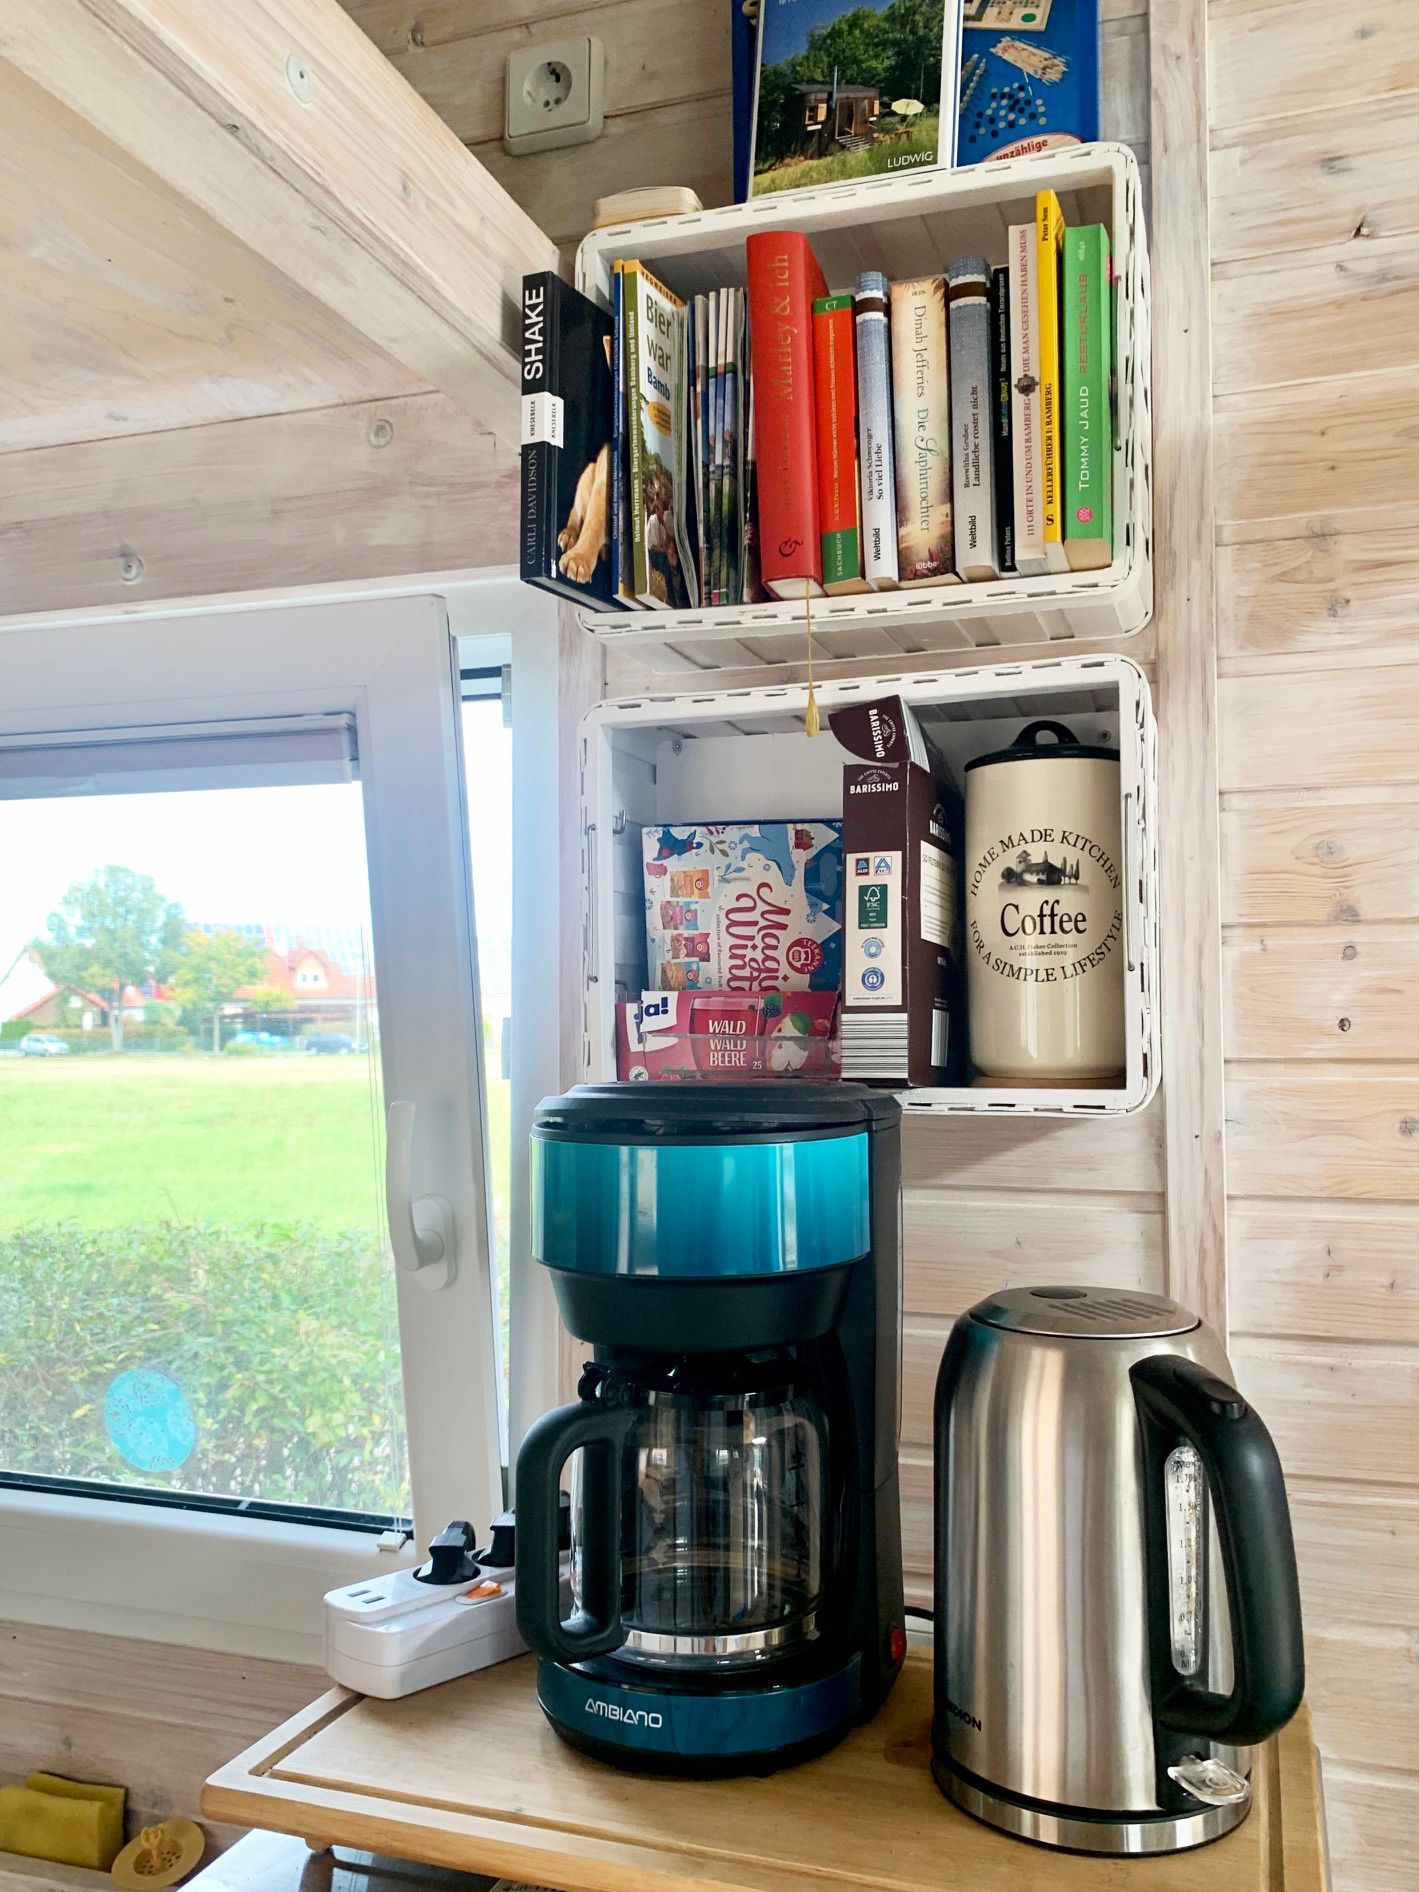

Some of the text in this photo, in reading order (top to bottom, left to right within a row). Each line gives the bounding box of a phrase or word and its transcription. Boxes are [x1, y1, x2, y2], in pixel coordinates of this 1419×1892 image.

[887, 151, 933, 168] LUDWIG
[768, 254, 790, 287] ich
[770, 295, 790, 316] &
[1018, 229, 1031, 373] DIE MAN GESEHEN HABEN MUSS
[523, 285, 545, 381] SHAKE
[914, 305, 928, 344] Dinah
[768, 321, 798, 401] Marley
[912, 348, 930, 398] Jefferies
[1023, 398, 1032, 444] BAMBERG
[1044, 382, 1053, 426] BAMBERG
[630, 388, 639, 473] Biergartenwanderungen
[970, 385, 981, 487] Landliebe rostet nicht
[1078, 386, 1090, 492] TOMMY JAUD
[865, 427, 875, 502] Viktoria Schwenger
[875, 443, 884, 500] So viel Liebe
[914, 407, 939, 533] Die Saphirtochter
[961, 423, 971, 489] Roswitha Gruber
[1024, 445, 1032, 461] UM
[1024, 461, 1033, 483] UND
[1045, 432, 1054, 505] KELLERFÜHRER
[526, 449, 537, 565] CARLI DAVIDSON
[1025, 484, 1033, 495] IN
[1025, 496, 1034, 523] ORTE
[872, 528, 881, 562] Weltbild
[968, 514, 977, 550] Weltbild
[868, 708, 886, 758] BARISSIMO
[849, 781, 899, 795] BARISSIMO
[970, 846, 1000, 897] HOME
[998, 828, 1055, 854] MADE
[1059, 830, 1121, 889] KITCHEN
[1000, 898, 1087, 937] Coffee
[802, 939, 821, 973] TEEKANNE
[970, 920, 985, 955] FOR
[981, 951, 992, 966] A
[991, 957, 1057, 983] SIMPLE
[1060, 909, 1123, 980] LIFESTYLE
[708, 1019, 747, 1035] WALD
[709, 1038, 747, 1051] WALD
[709, 1051, 748, 1067] BEERE
[752, 1060, 763, 1070] 25
[585, 1698, 663, 1728] AMBIANO
